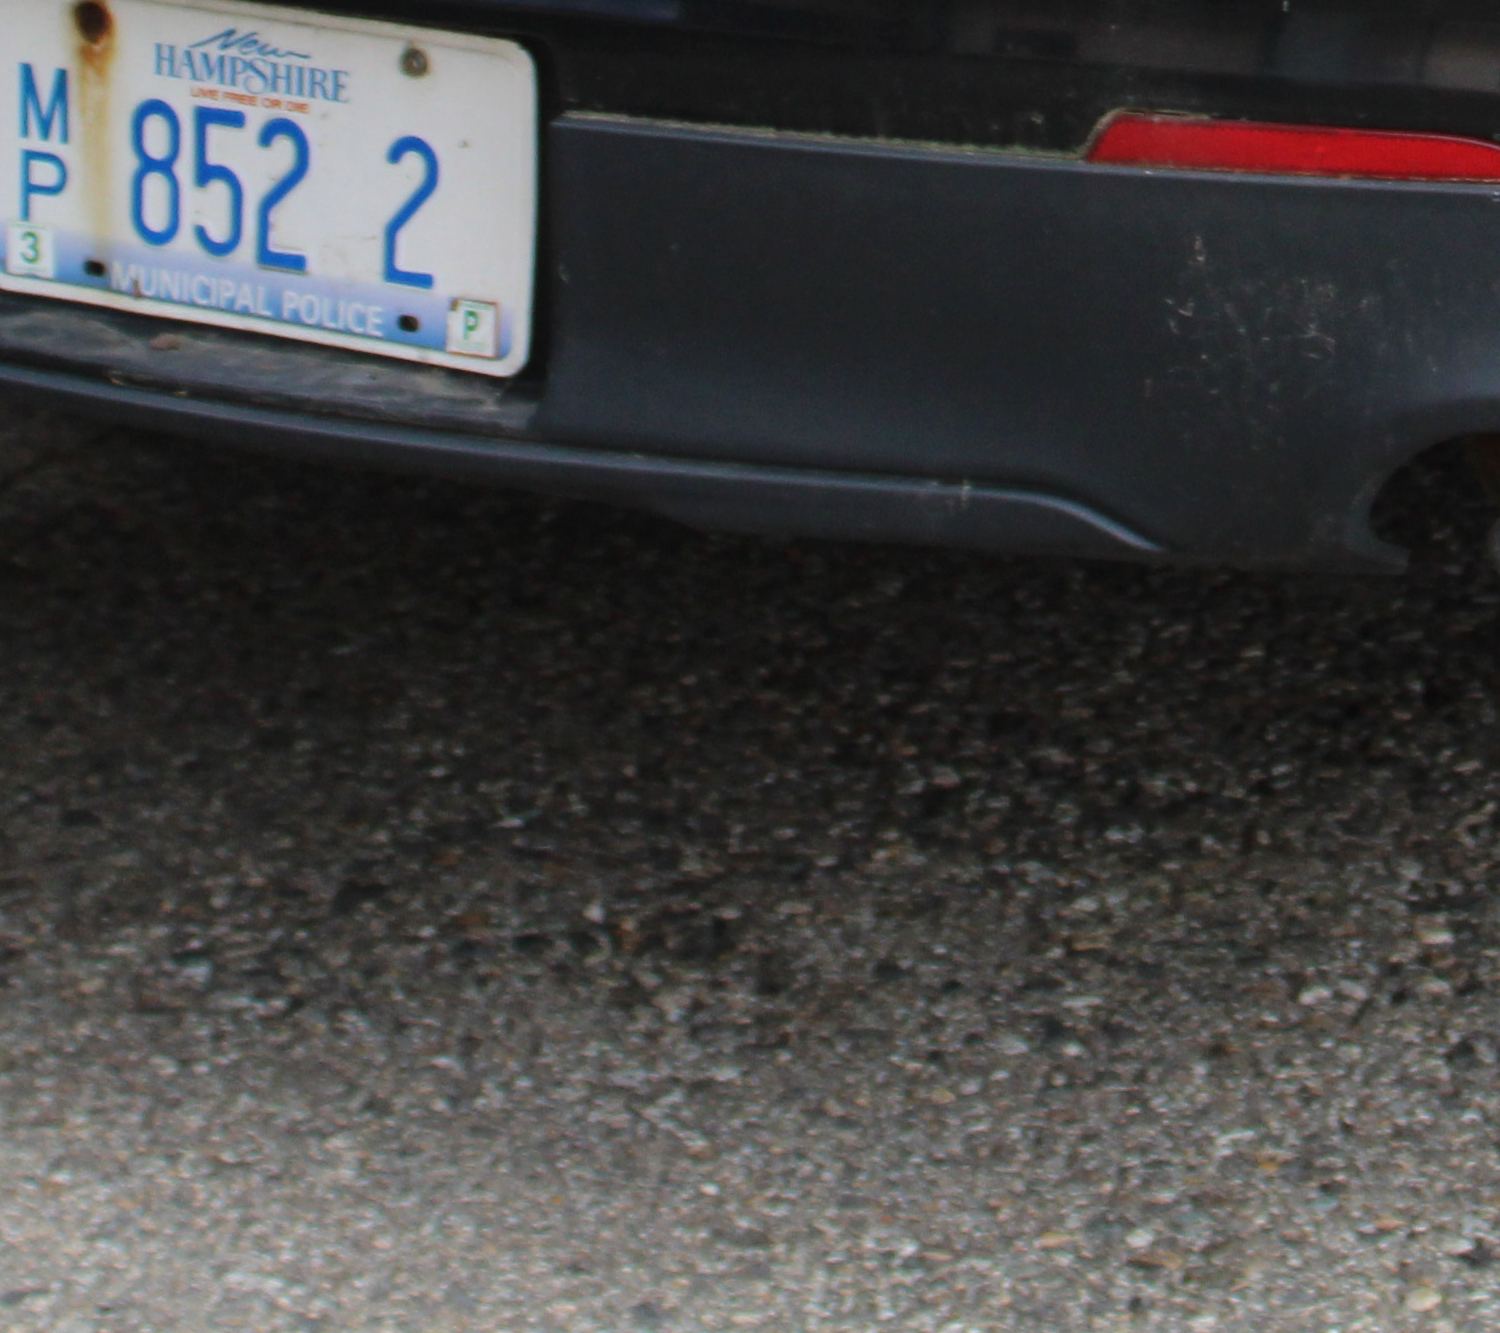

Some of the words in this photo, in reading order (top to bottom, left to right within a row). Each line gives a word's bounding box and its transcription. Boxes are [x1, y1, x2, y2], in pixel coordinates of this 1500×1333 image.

[188, 28, 313, 60] New
[154, 42, 351, 104] HAMPSHIRE
[190, 87, 221, 100] LIVE
[222, 91, 259, 106] FREE
[261, 96, 283, 110] OR
[284, 100, 310, 115] DIE
[19, 230, 41, 265] 3
[108, 260, 274, 318] MUNICIPAL
[281, 290, 386, 339] POLICE
[462, 309, 480, 341] P
